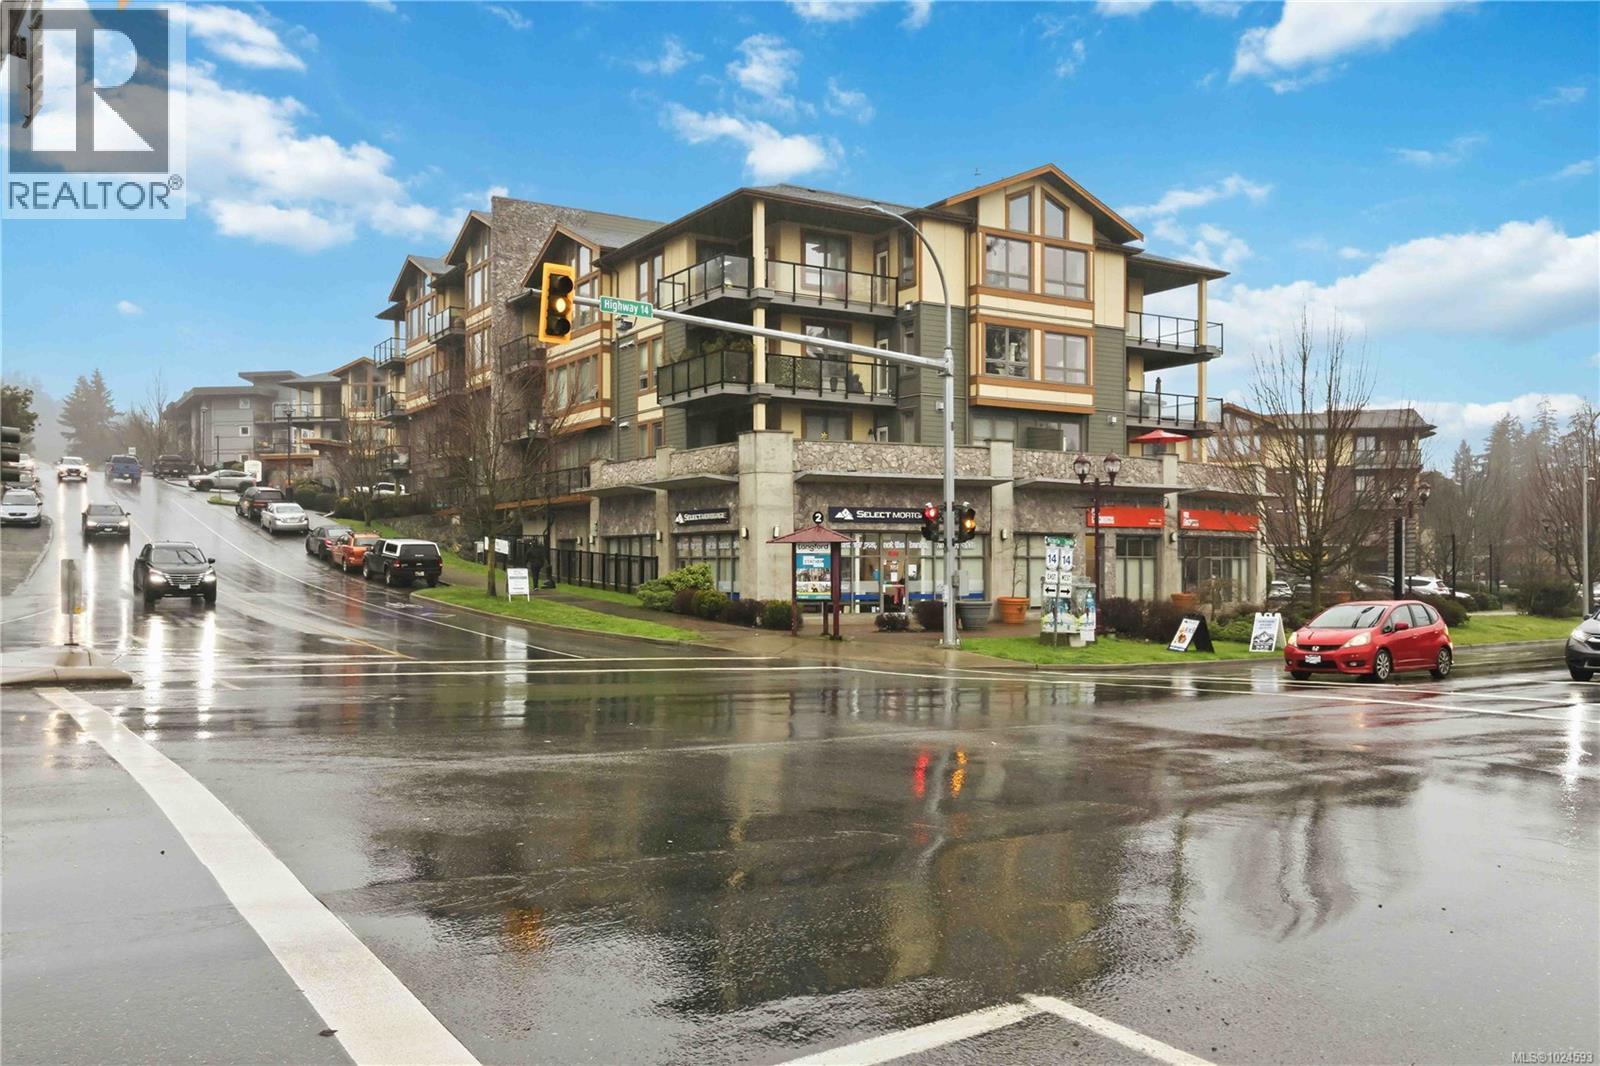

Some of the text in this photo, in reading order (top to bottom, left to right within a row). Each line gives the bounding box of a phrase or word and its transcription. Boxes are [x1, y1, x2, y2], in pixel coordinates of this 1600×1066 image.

[604, 299, 649, 315] Highway 14
[814, 513, 822, 523] 2
[1048, 554, 1057, 564] 14
[1062, 555, 1071, 565] 14
